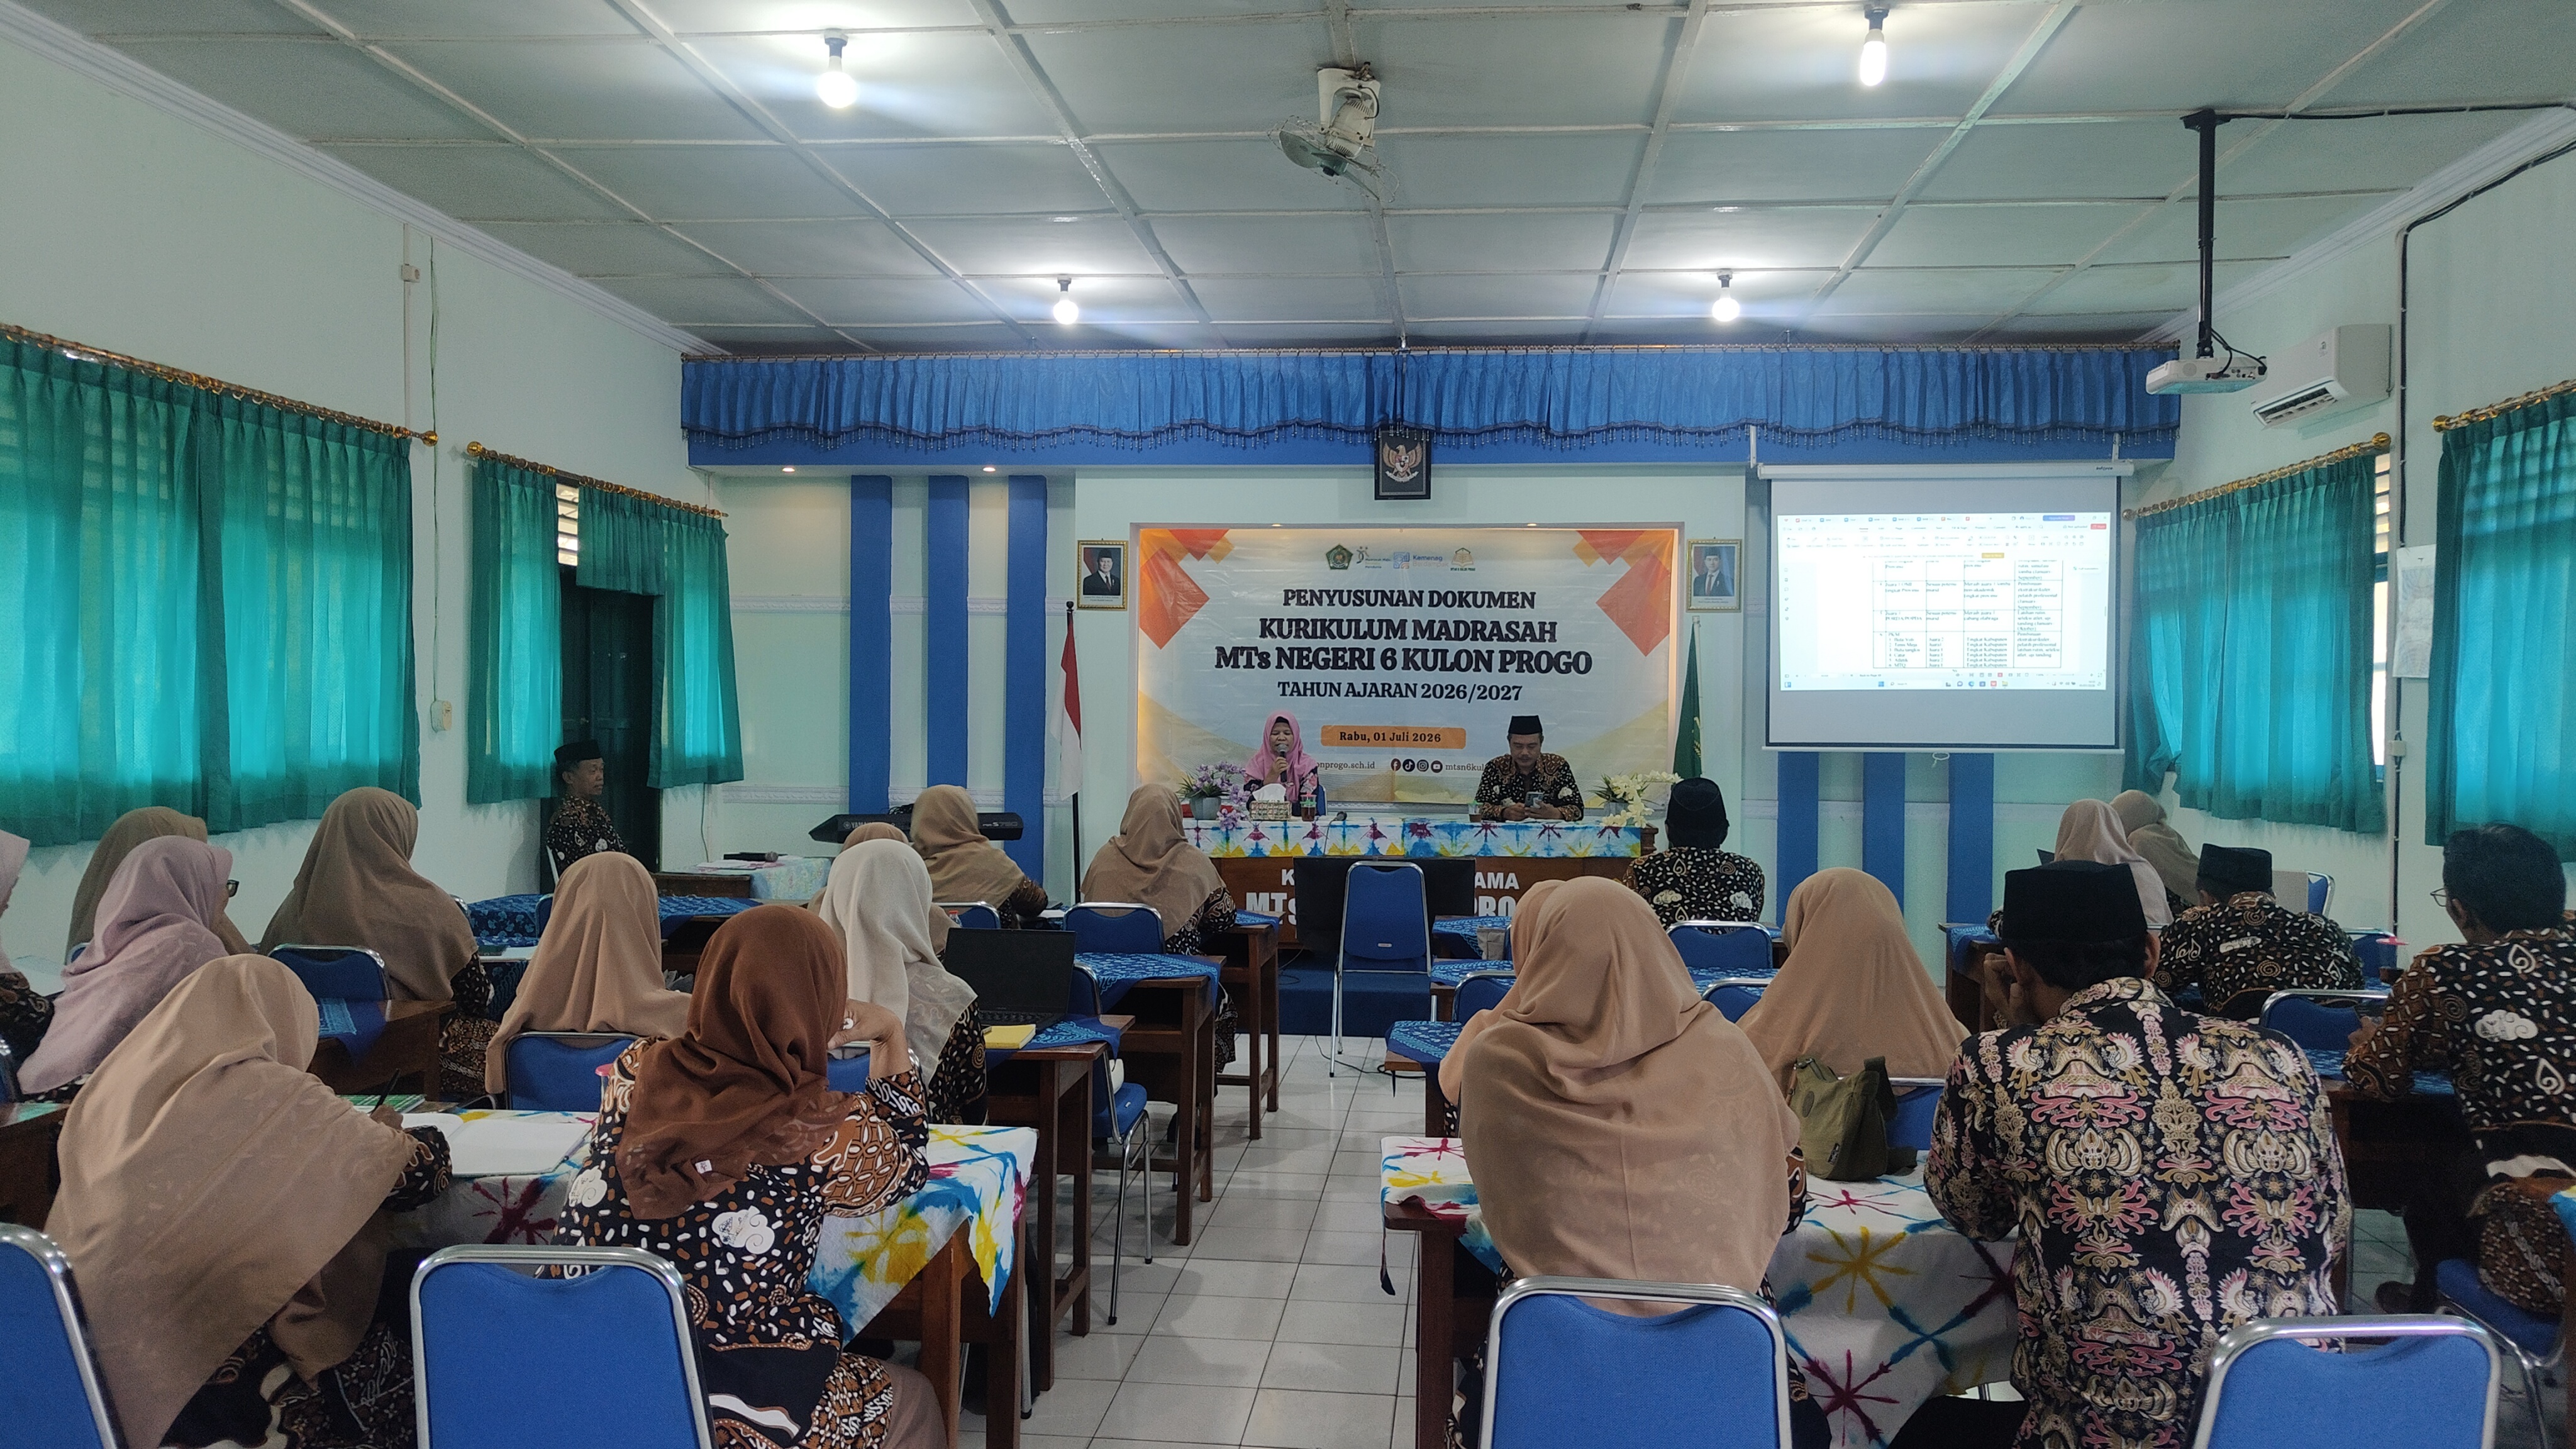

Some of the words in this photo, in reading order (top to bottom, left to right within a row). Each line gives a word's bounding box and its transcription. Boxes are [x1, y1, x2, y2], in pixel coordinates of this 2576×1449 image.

[1283, 589, 1424, 608] PENYUSUNAN
[1428, 590, 1536, 609] DOKUMEN
[1259, 618, 1407, 640] KURIKULUM
[1411, 619, 1558, 643] MADRASAH
[1215, 646, 1271, 669] MTs
[1275, 647, 1375, 670] NEGERI
[1380, 648, 1397, 670] 6
[1401, 648, 1495, 673] KULON
[1498, 650, 1592, 675] PROGO
[1278, 681, 1346, 697] TAHUN
[1344, 682, 1418, 698] AJARAN
[1421, 684, 1523, 703] 2026/2027
[1340, 731, 1370, 743] Rabu,
[1373, 732, 1386, 741] 01
[1389, 731, 1409, 741] Juli
[1413, 733, 1441, 742] 2026
